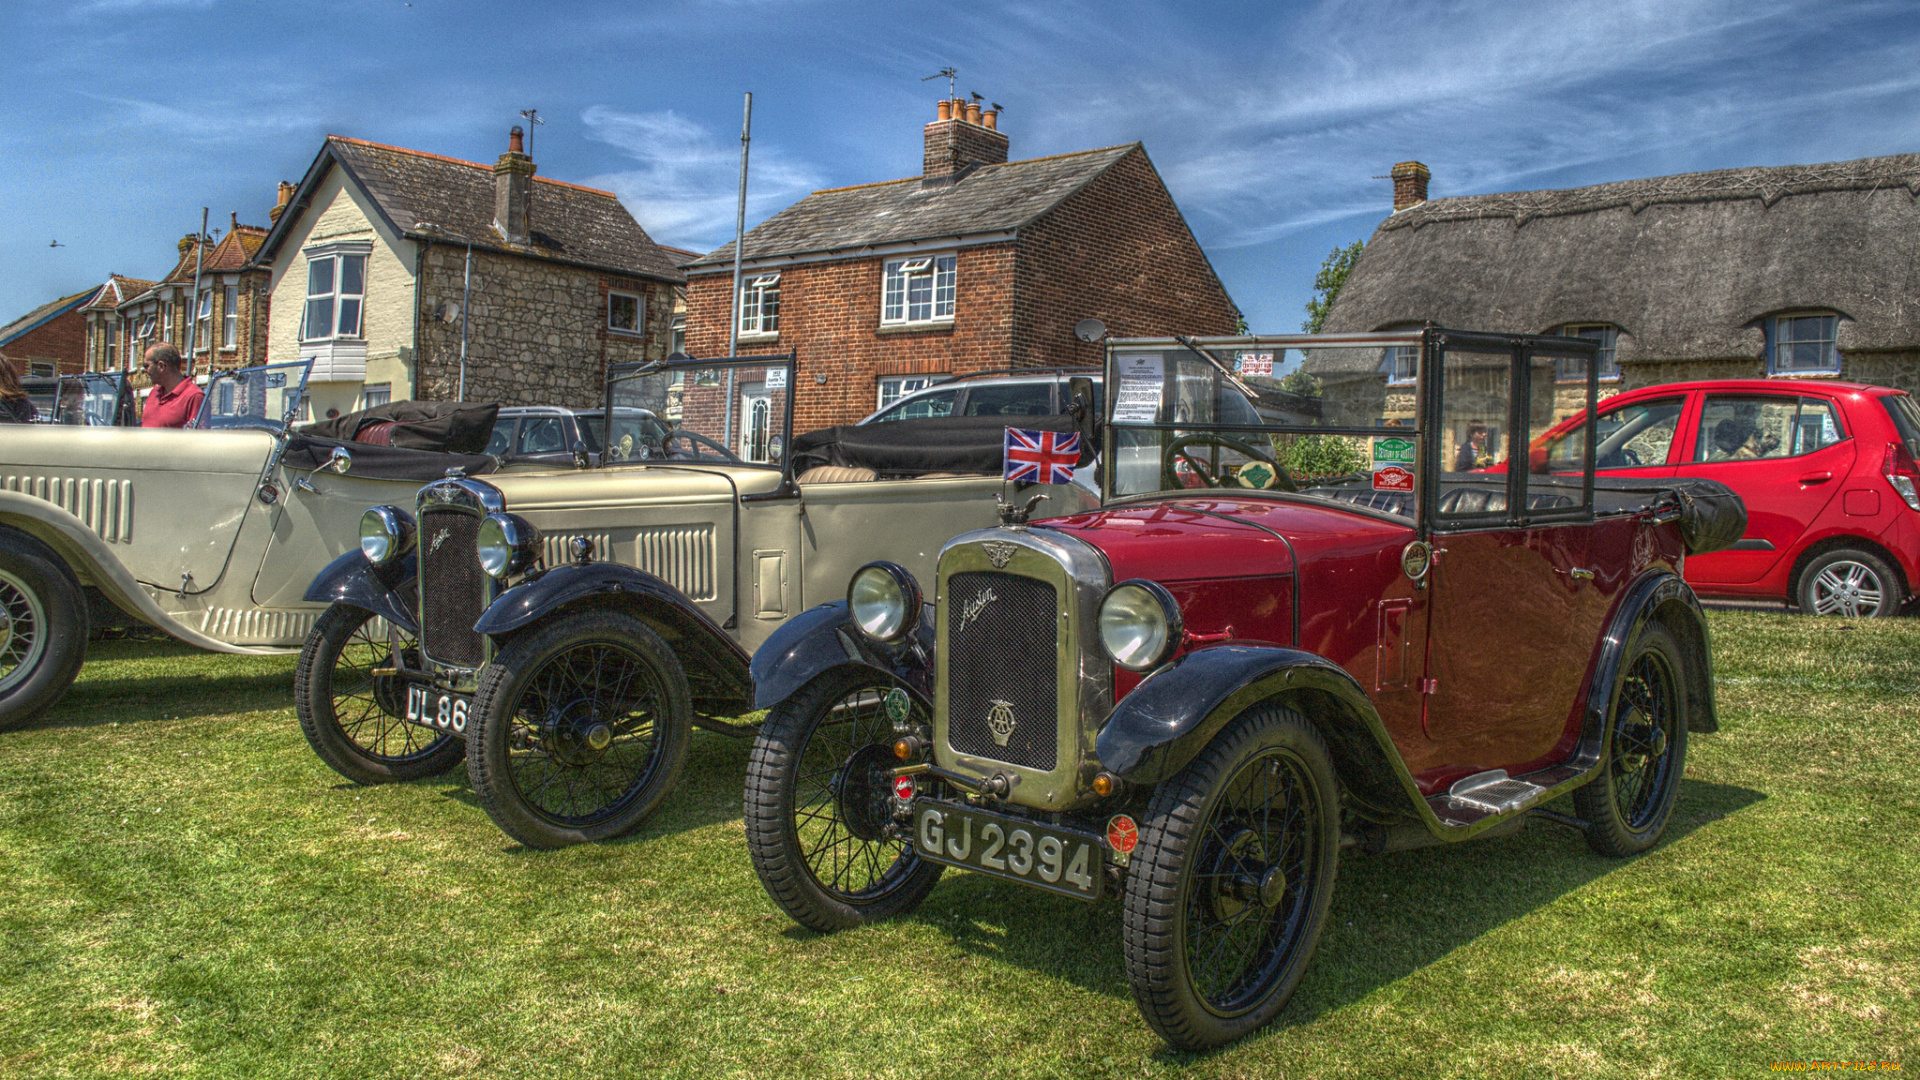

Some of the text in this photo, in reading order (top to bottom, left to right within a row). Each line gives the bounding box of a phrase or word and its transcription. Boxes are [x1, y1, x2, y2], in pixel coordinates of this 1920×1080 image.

[960, 588, 997, 632] Austin
[407, 687, 473, 733] DL 86
[920, 809, 1092, 891] GJ 2394
